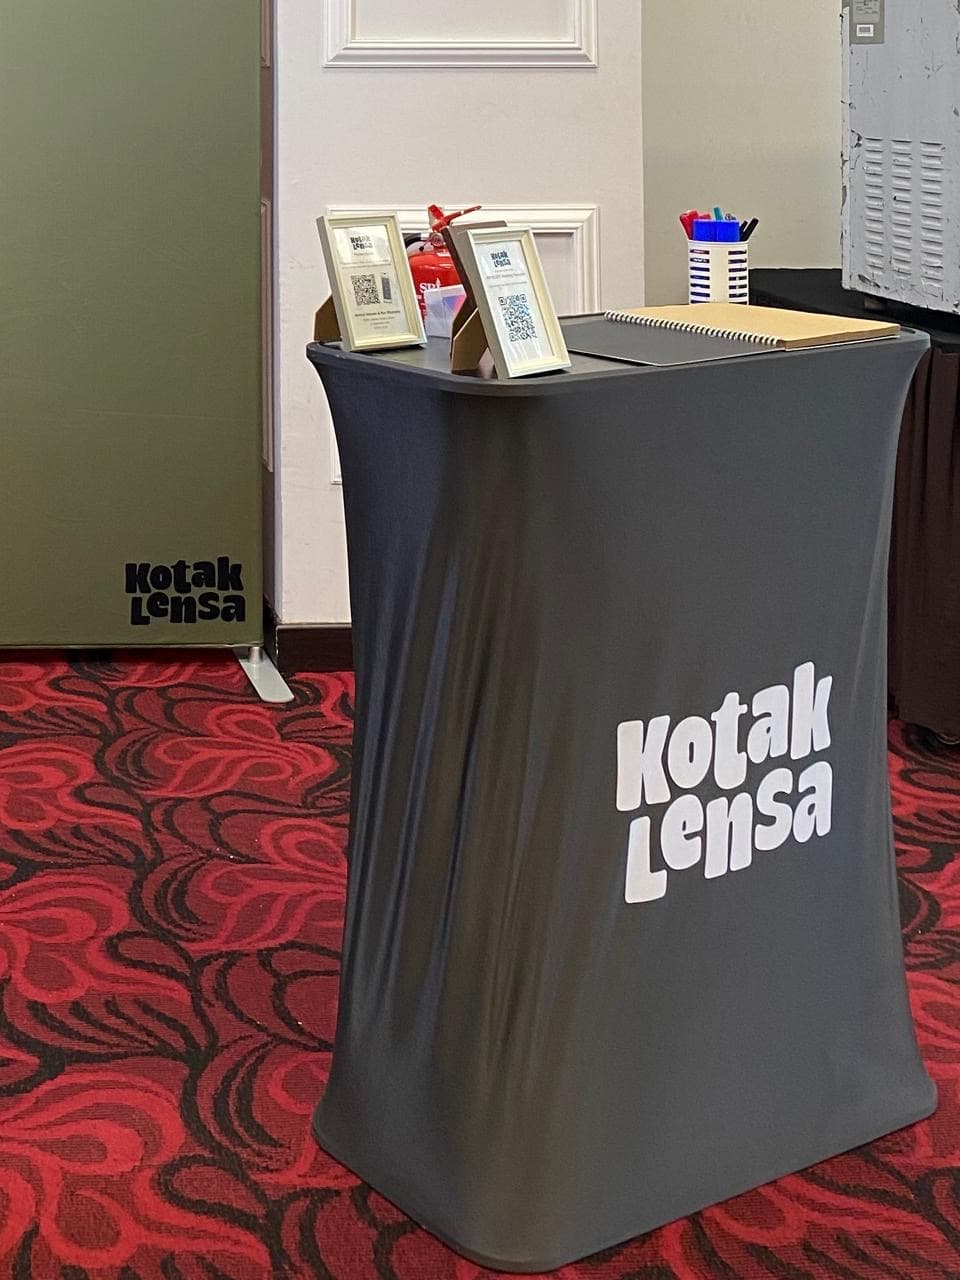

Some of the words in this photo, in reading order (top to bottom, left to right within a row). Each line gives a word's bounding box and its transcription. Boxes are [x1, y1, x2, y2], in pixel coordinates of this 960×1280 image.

[125, 556, 244, 594] Kotak
[130, 591, 246, 626] Lensa
[616, 661, 833, 812] Kotak
[625, 761, 833, 904] Lensa
